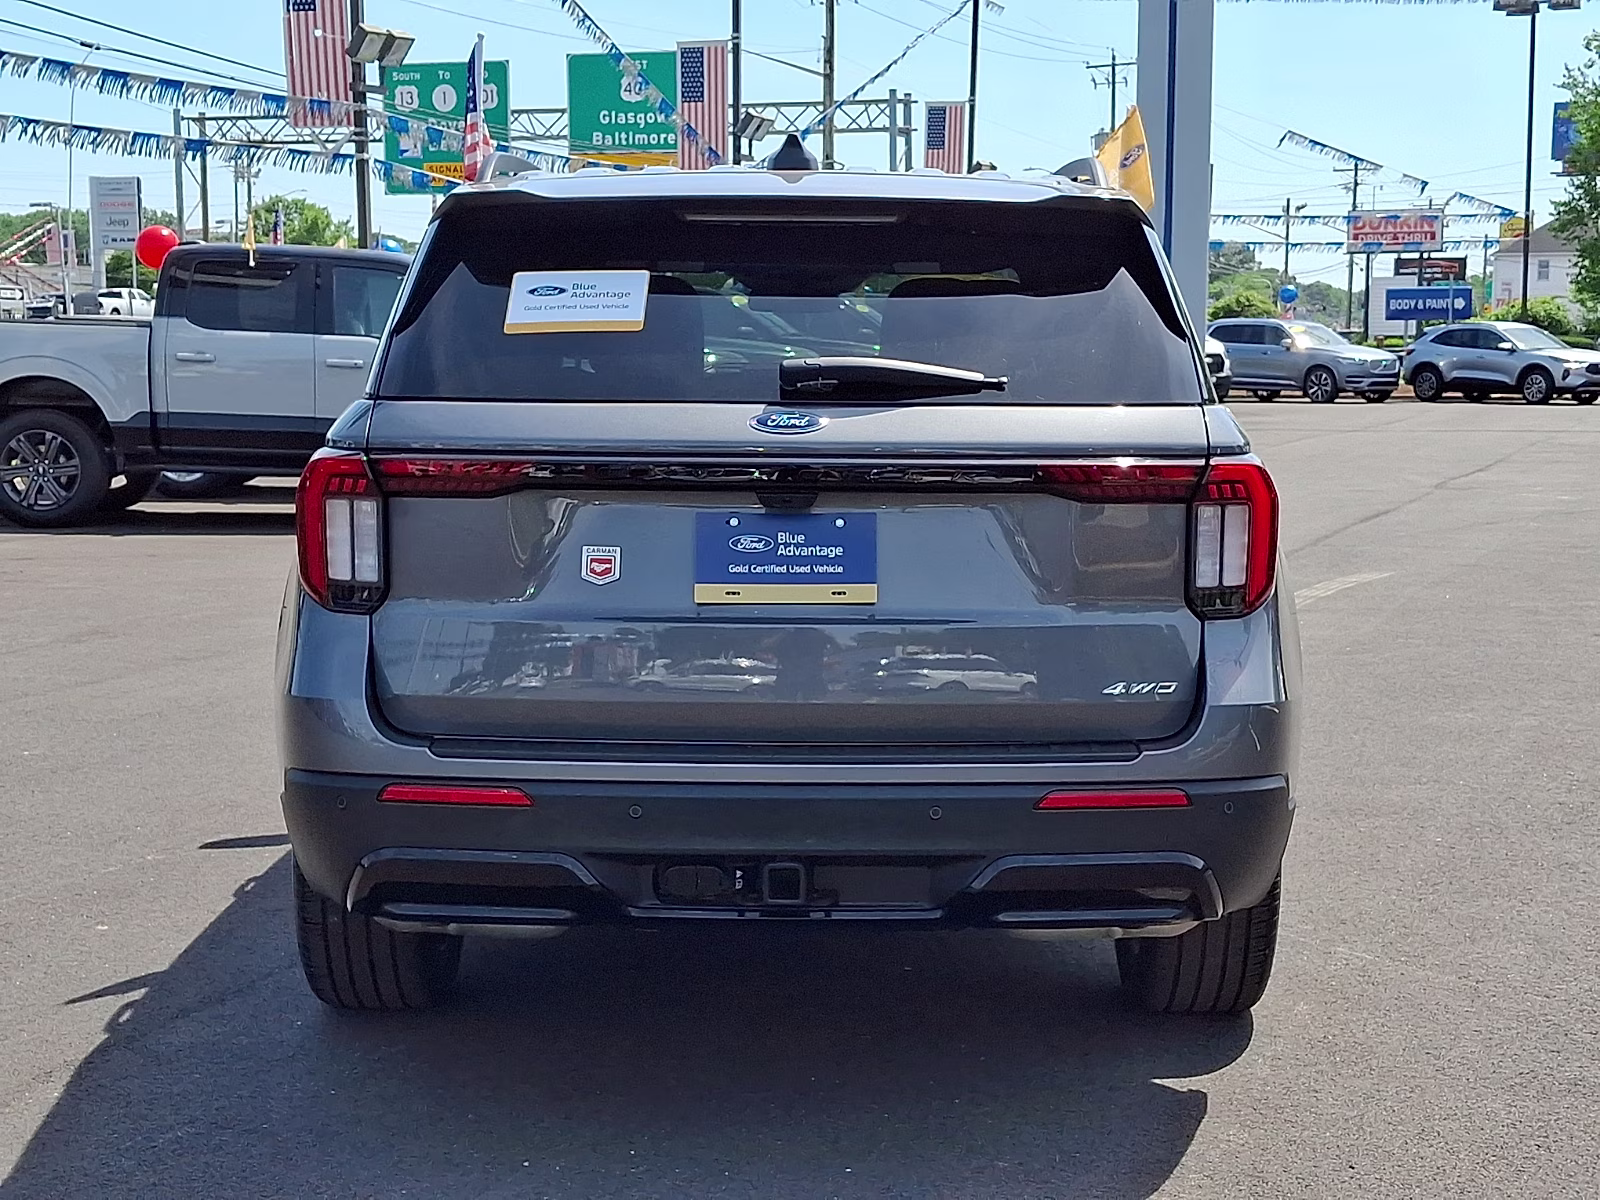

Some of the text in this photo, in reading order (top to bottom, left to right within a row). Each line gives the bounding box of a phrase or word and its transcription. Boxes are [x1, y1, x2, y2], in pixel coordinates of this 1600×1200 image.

[392, 71, 420, 81] SOUTH
[438, 70, 450, 80] TO
[400, 91, 414, 105] 13
[592, 131, 676, 145] Baltimore
[106, 216, 129, 228] Jeep
[572, 282, 597, 290] Blue
[570, 291, 631, 300] Advantage
[1389, 299, 1452, 310] BODY & PAINT
[767, 412, 809, 427] Ford
[737, 536, 766, 549] Ford
[777, 532, 805, 543] Blue
[777, 544, 844, 558] Advantage
[728, 564, 844, 573] Gold Certified Used Vehicle
[1102, 681, 1179, 695] 4WD
